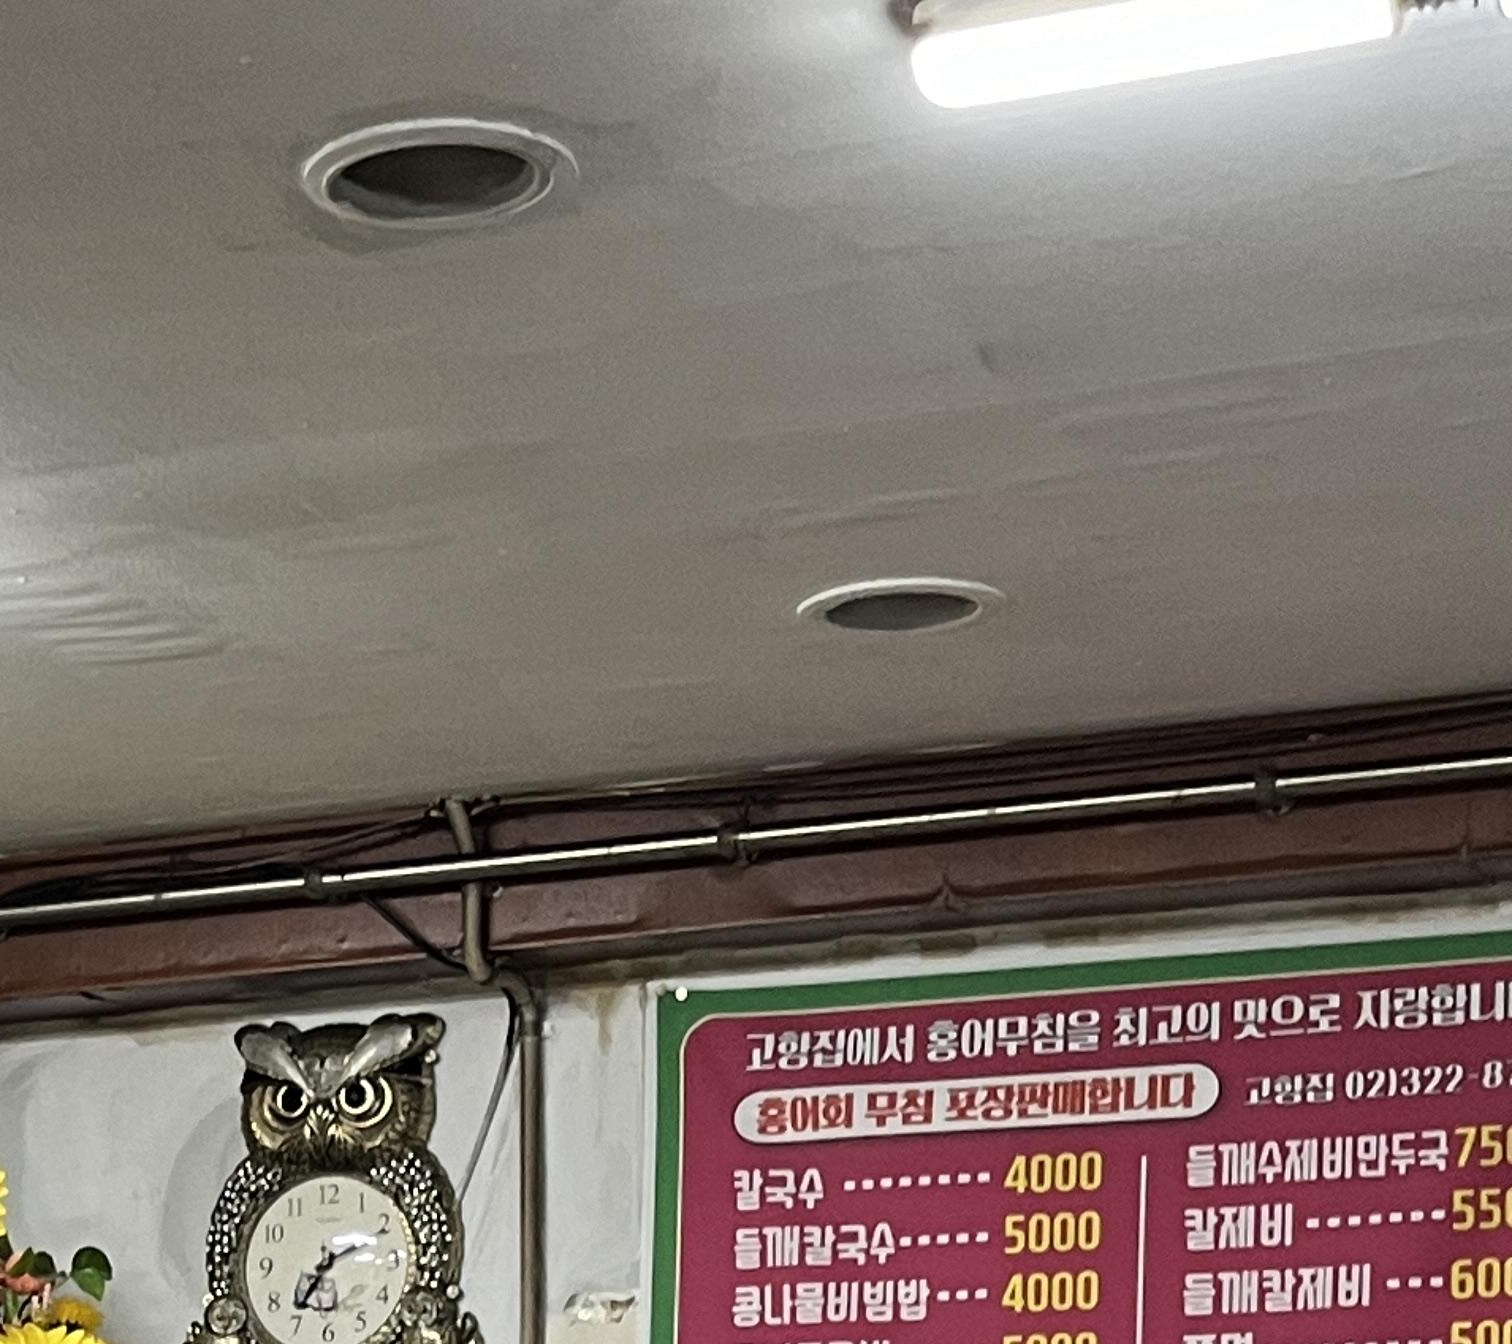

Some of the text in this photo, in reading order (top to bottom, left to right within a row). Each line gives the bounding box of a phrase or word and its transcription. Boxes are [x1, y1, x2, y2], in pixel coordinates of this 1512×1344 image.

[745, 980, 1512, 1072] 고향집에서 홍어무침을 최고의 맛으로 자랑합니
[1345, 1059, 1512, 1101] 02)322-8
[757, 1072, 1196, 1136] 홍어회 무침 포장판매합니다
[1186, 1129, 1449, 1188] 들깨수제비만두국
[733, 1151, 1103, 1211] 칼국수 4000
[320, 1184, 339, 1205] 12
[359, 1192, 365, 1213] 1
[288, 1198, 302, 1217] 11
[265, 1224, 284, 1244] 10
[377, 1213, 390, 1235] 2
[1184, 1203, 1293, 1251] 칼제비
[734, 1211, 1101, 1270] 들깨칼국수 5000
[259, 1257, 273, 1279] 9
[376, 1285, 388, 1304] 4
[732, 1270, 1100, 1328] 콩나물비빔밥 4000
[1183, 1263, 1371, 1316] 들깨칼제비
[268, 1291, 281, 1313] 8
[290, 1315, 302, 1336] 7
[322, 1322, 334, 1342] 6
[355, 1311, 367, 1332] 5
